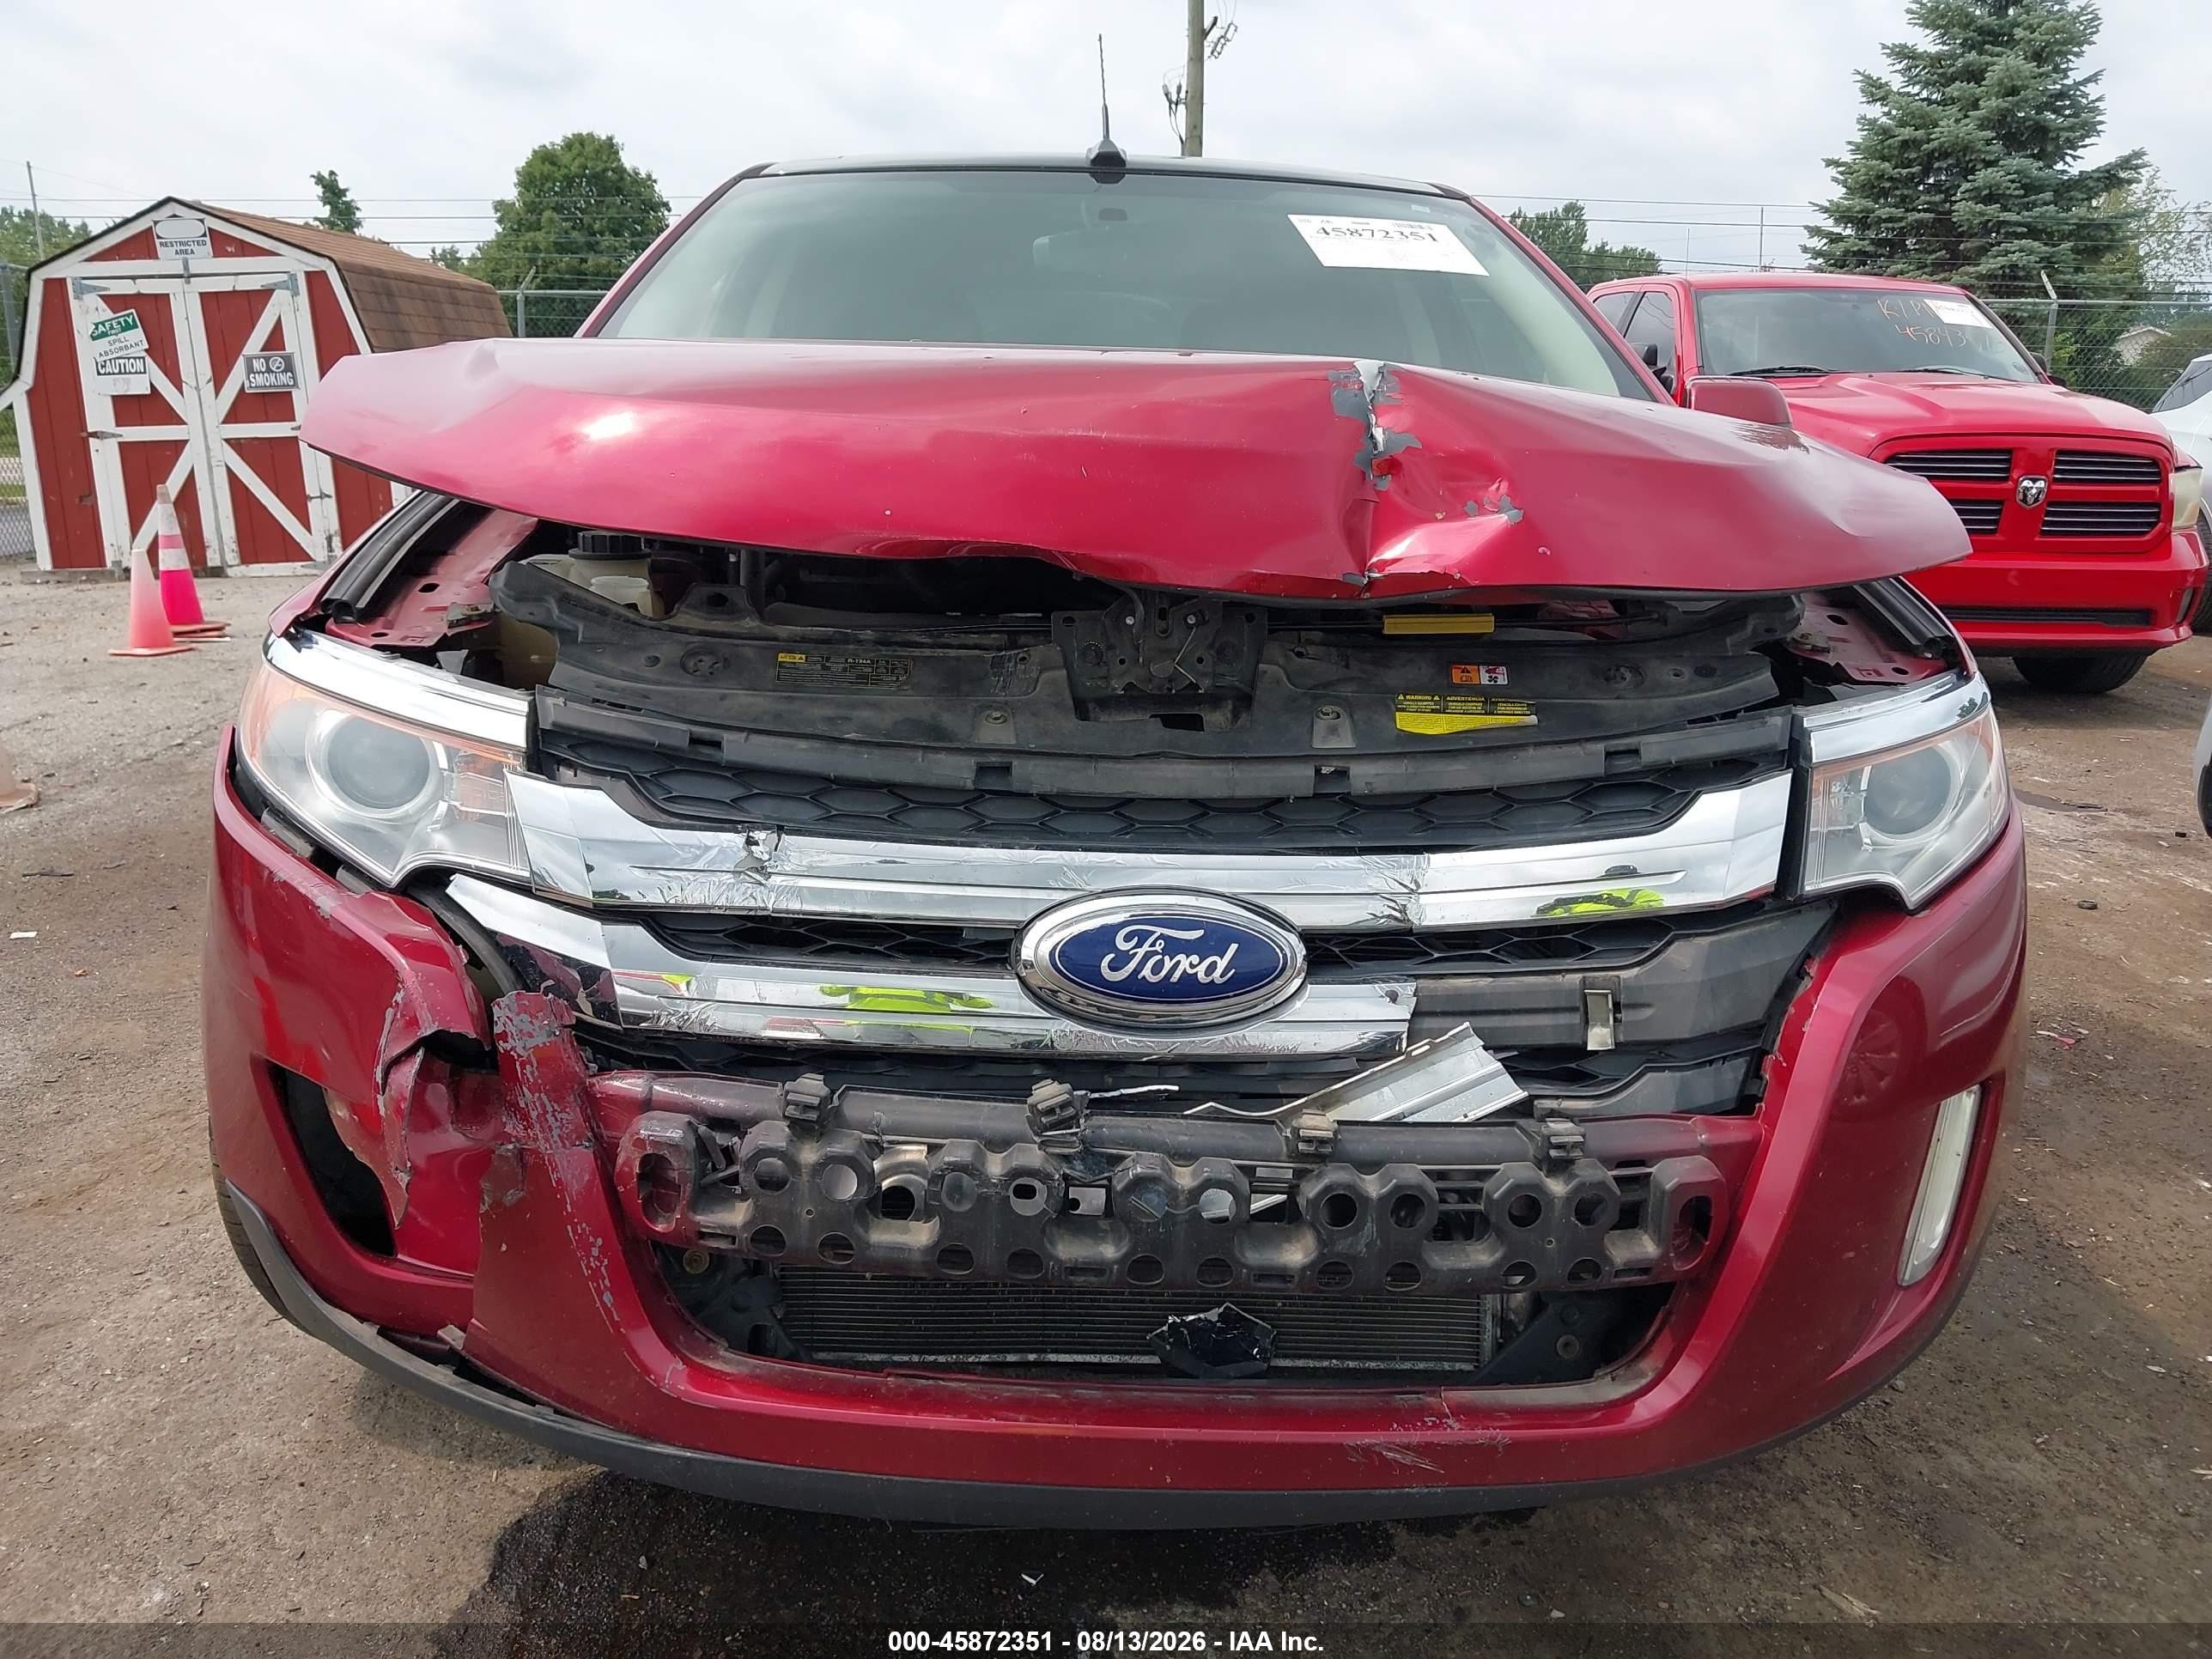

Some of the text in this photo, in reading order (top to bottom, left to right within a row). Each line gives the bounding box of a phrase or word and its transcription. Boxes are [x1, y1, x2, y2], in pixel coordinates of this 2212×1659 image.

[1316, 227, 1438, 242] 45872351
[159, 240, 207, 248] RESTRICTED
[91, 314, 135, 337] SAFETY
[98, 339, 144, 358] ABSORBANT
[107, 337, 130, 347] SPILL
[98, 357, 144, 374] CAUTION
[252, 358, 266, 372] NO
[249, 371, 294, 387] SMOKING
[1101, 925, 1239, 984] Ford
